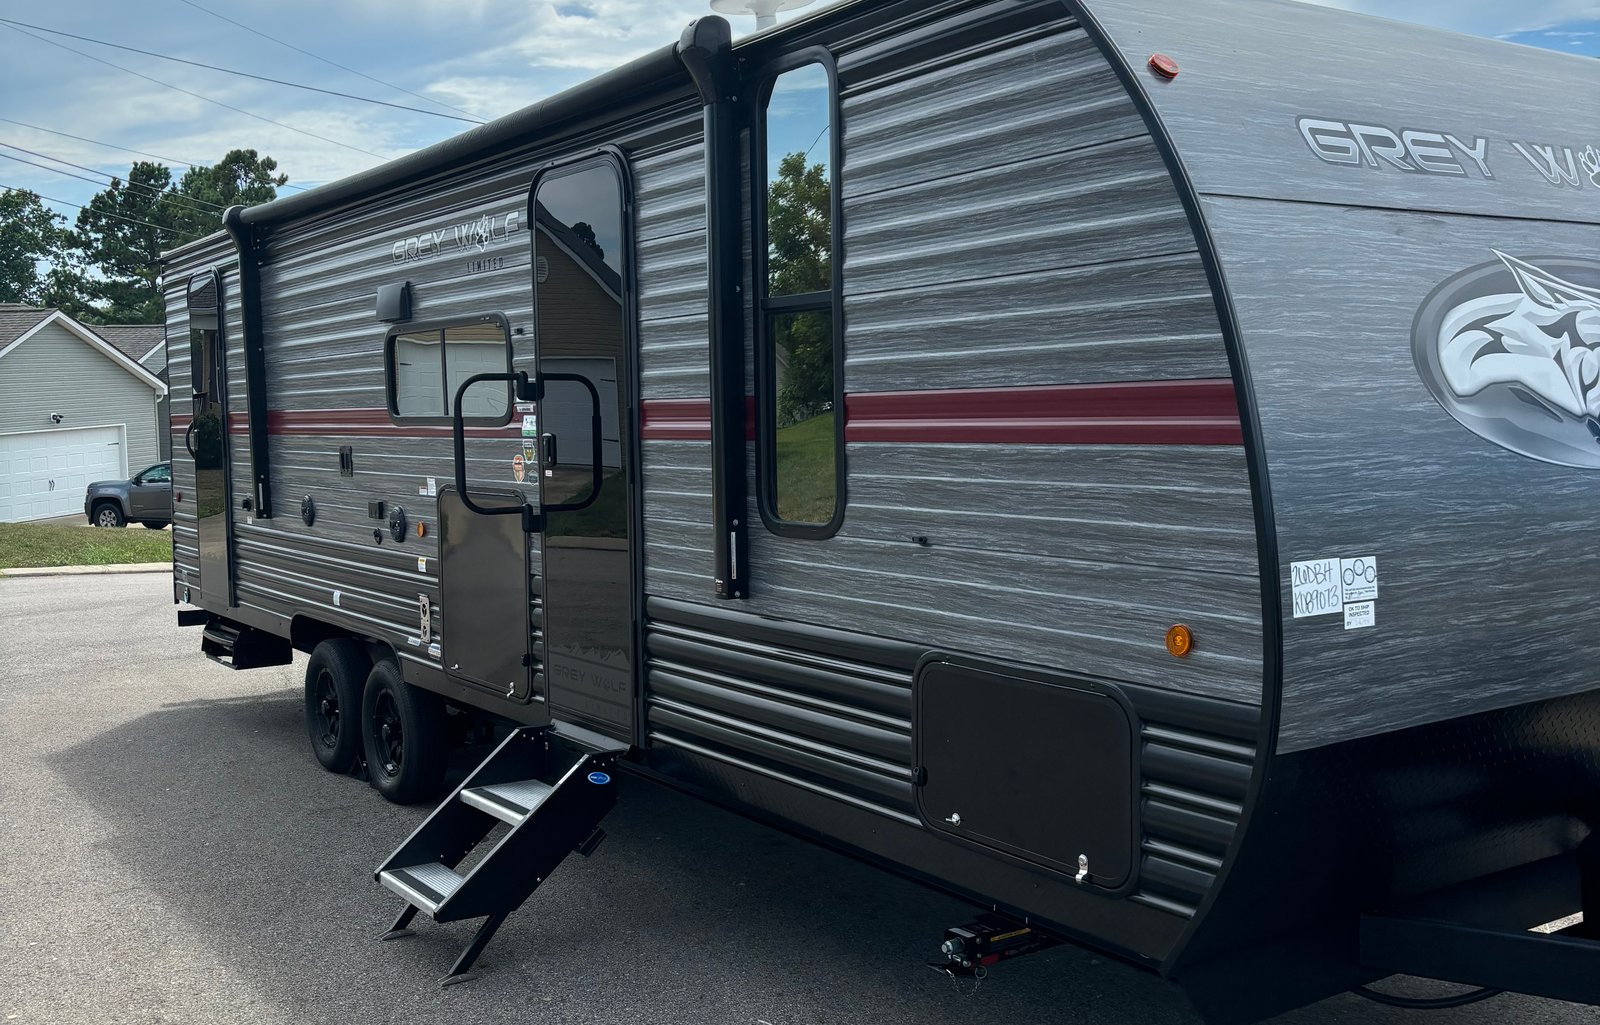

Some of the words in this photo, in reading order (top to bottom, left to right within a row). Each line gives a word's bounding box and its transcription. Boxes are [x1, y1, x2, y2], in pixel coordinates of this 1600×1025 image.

[1296, 115, 1495, 179] GREY
[392, 229, 446, 265] GREY
[454, 212, 519, 253] WOLF
[467, 256, 504, 273] LIMITED
[1348, 610, 1370, 618] INSPECTED
[553, 664, 586, 682] GREY
